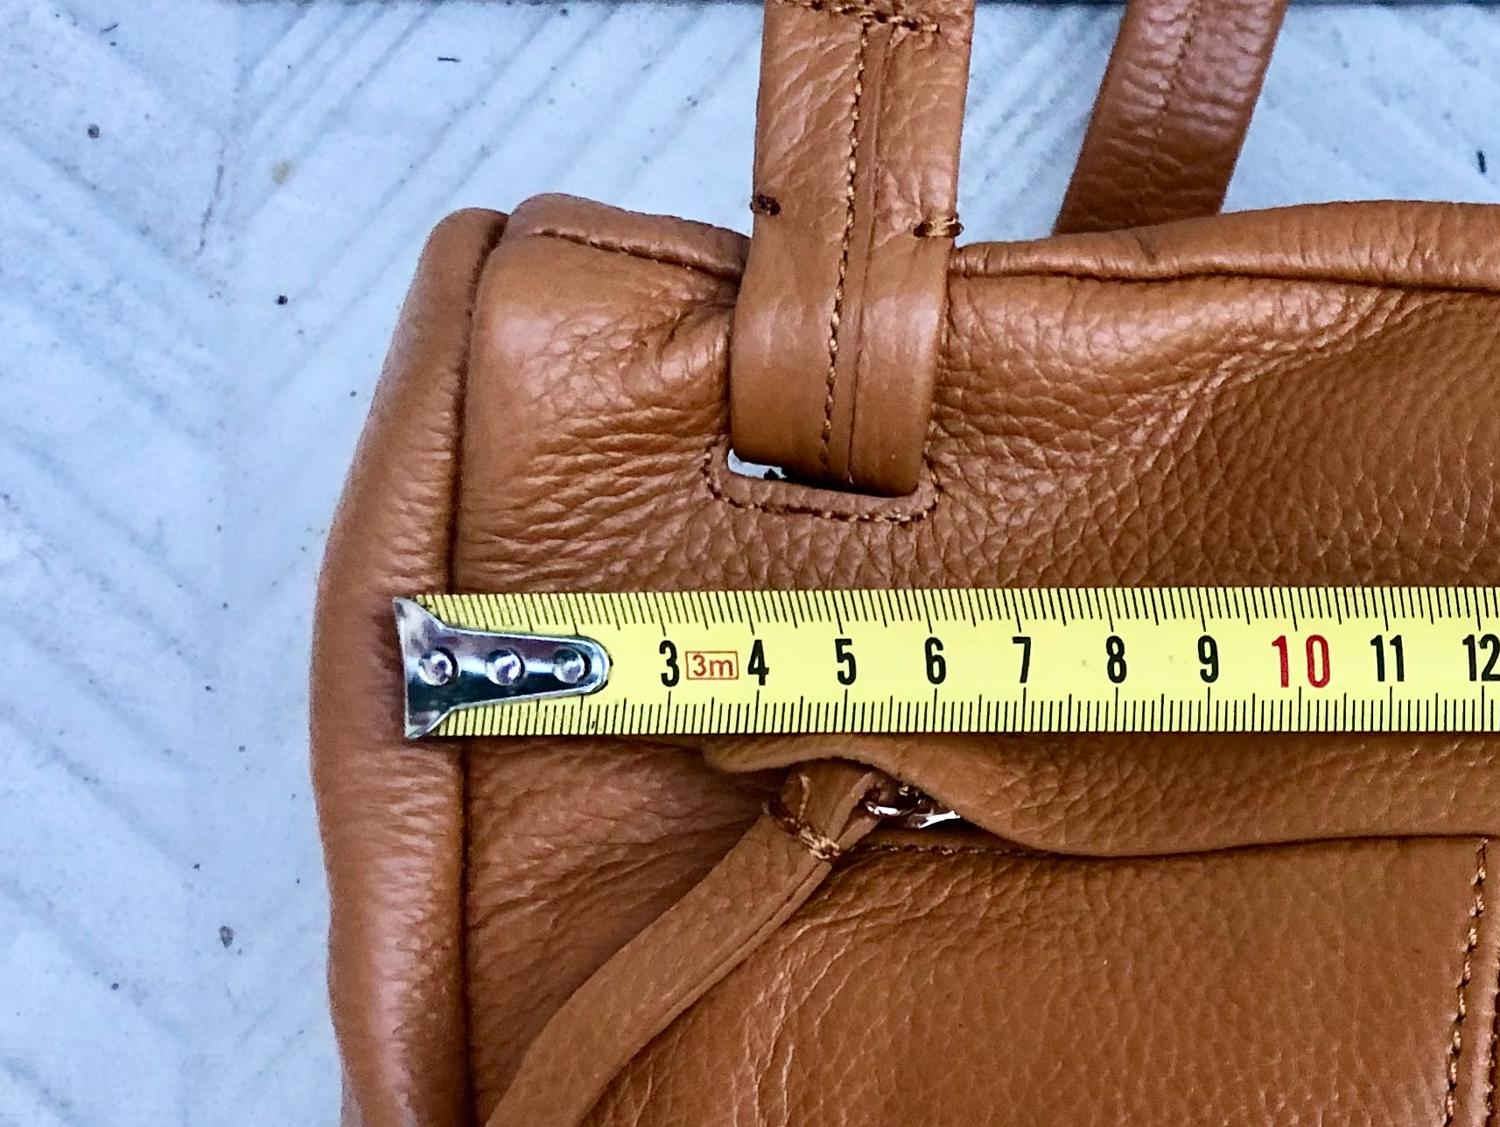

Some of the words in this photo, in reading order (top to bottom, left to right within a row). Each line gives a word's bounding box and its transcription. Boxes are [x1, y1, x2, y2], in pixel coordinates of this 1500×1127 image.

[658, 639, 680, 688] 3
[692, 653, 734, 677] 3m
[747, 639, 770, 686] 4
[834, 638, 857, 686] 5
[924, 636, 947, 685] 6
[1011, 635, 1032, 684] 7
[1105, 635, 1127, 684] 8
[1197, 634, 1219, 684] 9
[1270, 634, 1331, 689] 10
[1370, 634, 1405, 682] 11
